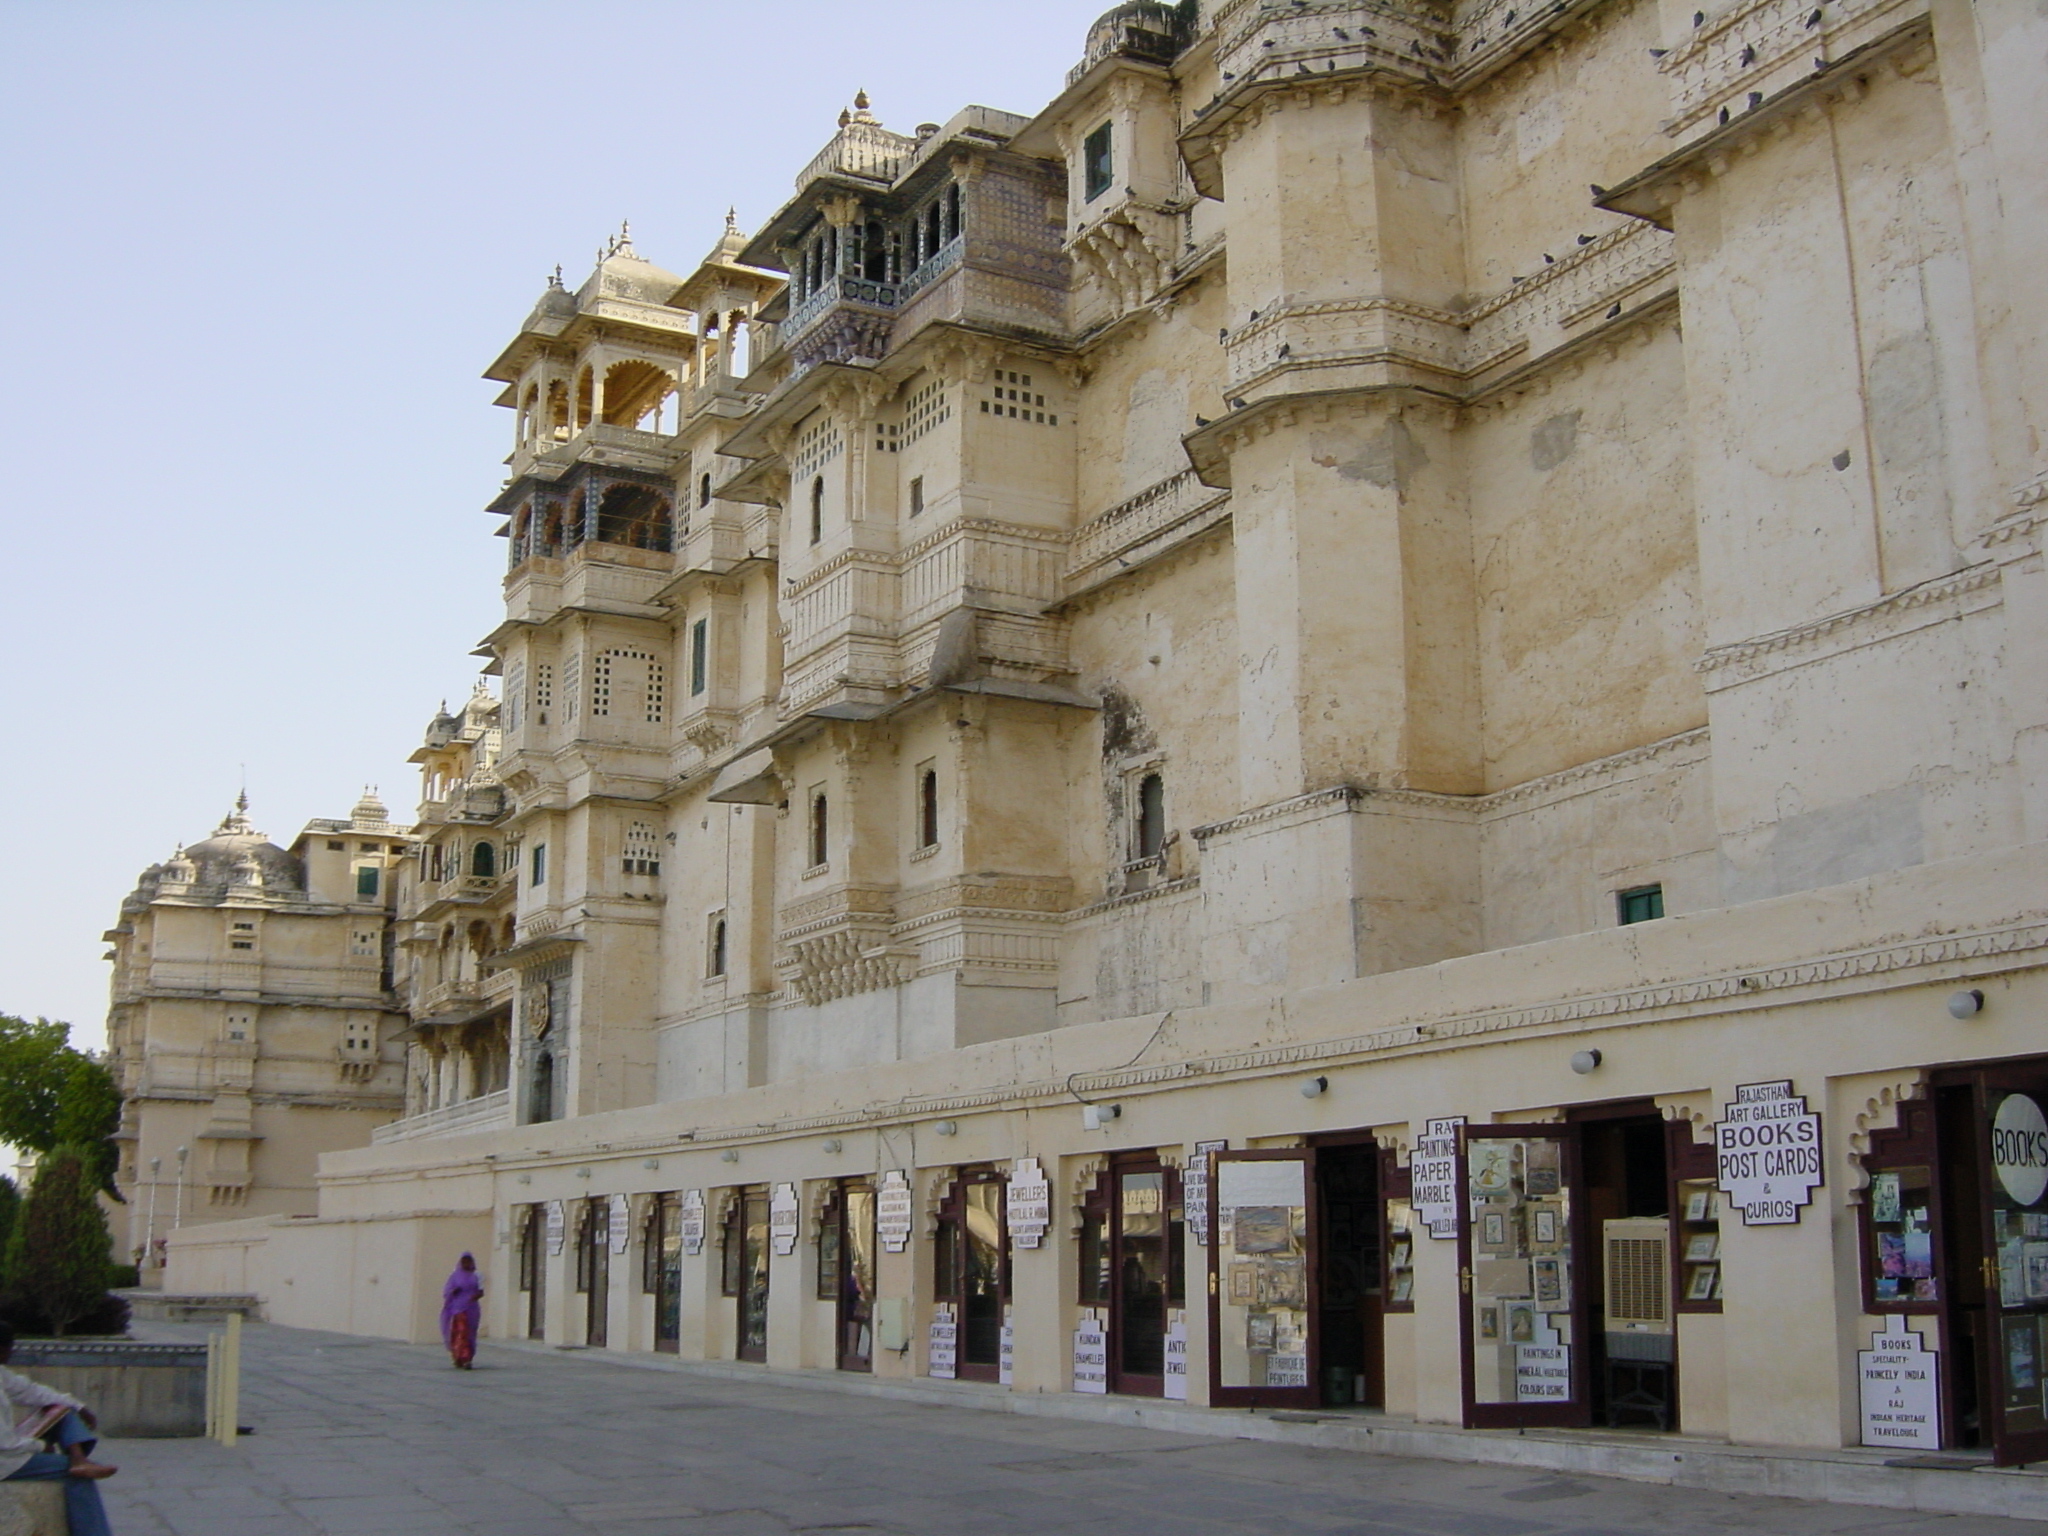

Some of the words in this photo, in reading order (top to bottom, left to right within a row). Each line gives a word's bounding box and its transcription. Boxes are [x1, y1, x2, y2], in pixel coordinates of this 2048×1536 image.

[1740, 1085, 1789, 1104] RAJASTHAN
[1729, 1107, 1749, 1123] ART
[1752, 1101, 1801, 1121] GALLERY
[1721, 1121, 1814, 1149] BOOKS
[1994, 1128, 2048, 1167] BOOKS
[1719, 1151, 1758, 1180] POST
[1764, 1147, 1818, 1177] CARDS
[1009, 1185, 1047, 1203] JEWELLERS
[1413, 1184, 1451, 1204] MARBLE
[1763, 1182, 1771, 1194] &
[1746, 1200, 1794, 1219] CURIOS
[1523, 1347, 1555, 1359] PAINTINGS
[1881, 1339, 1911, 1350] BOOKS
[1865, 1369, 1899, 1380] PRINCELY
[1904, 1370, 1926, 1380] INDIA
[1519, 1383, 1545, 1396] COLOURS
[1546, 1384, 1565, 1396] USING
[1888, 1400, 1904, 1409] RAJ
[1870, 1413, 1893, 1422] INDIAN
[1895, 1413, 1926, 1423] HERITAGE
